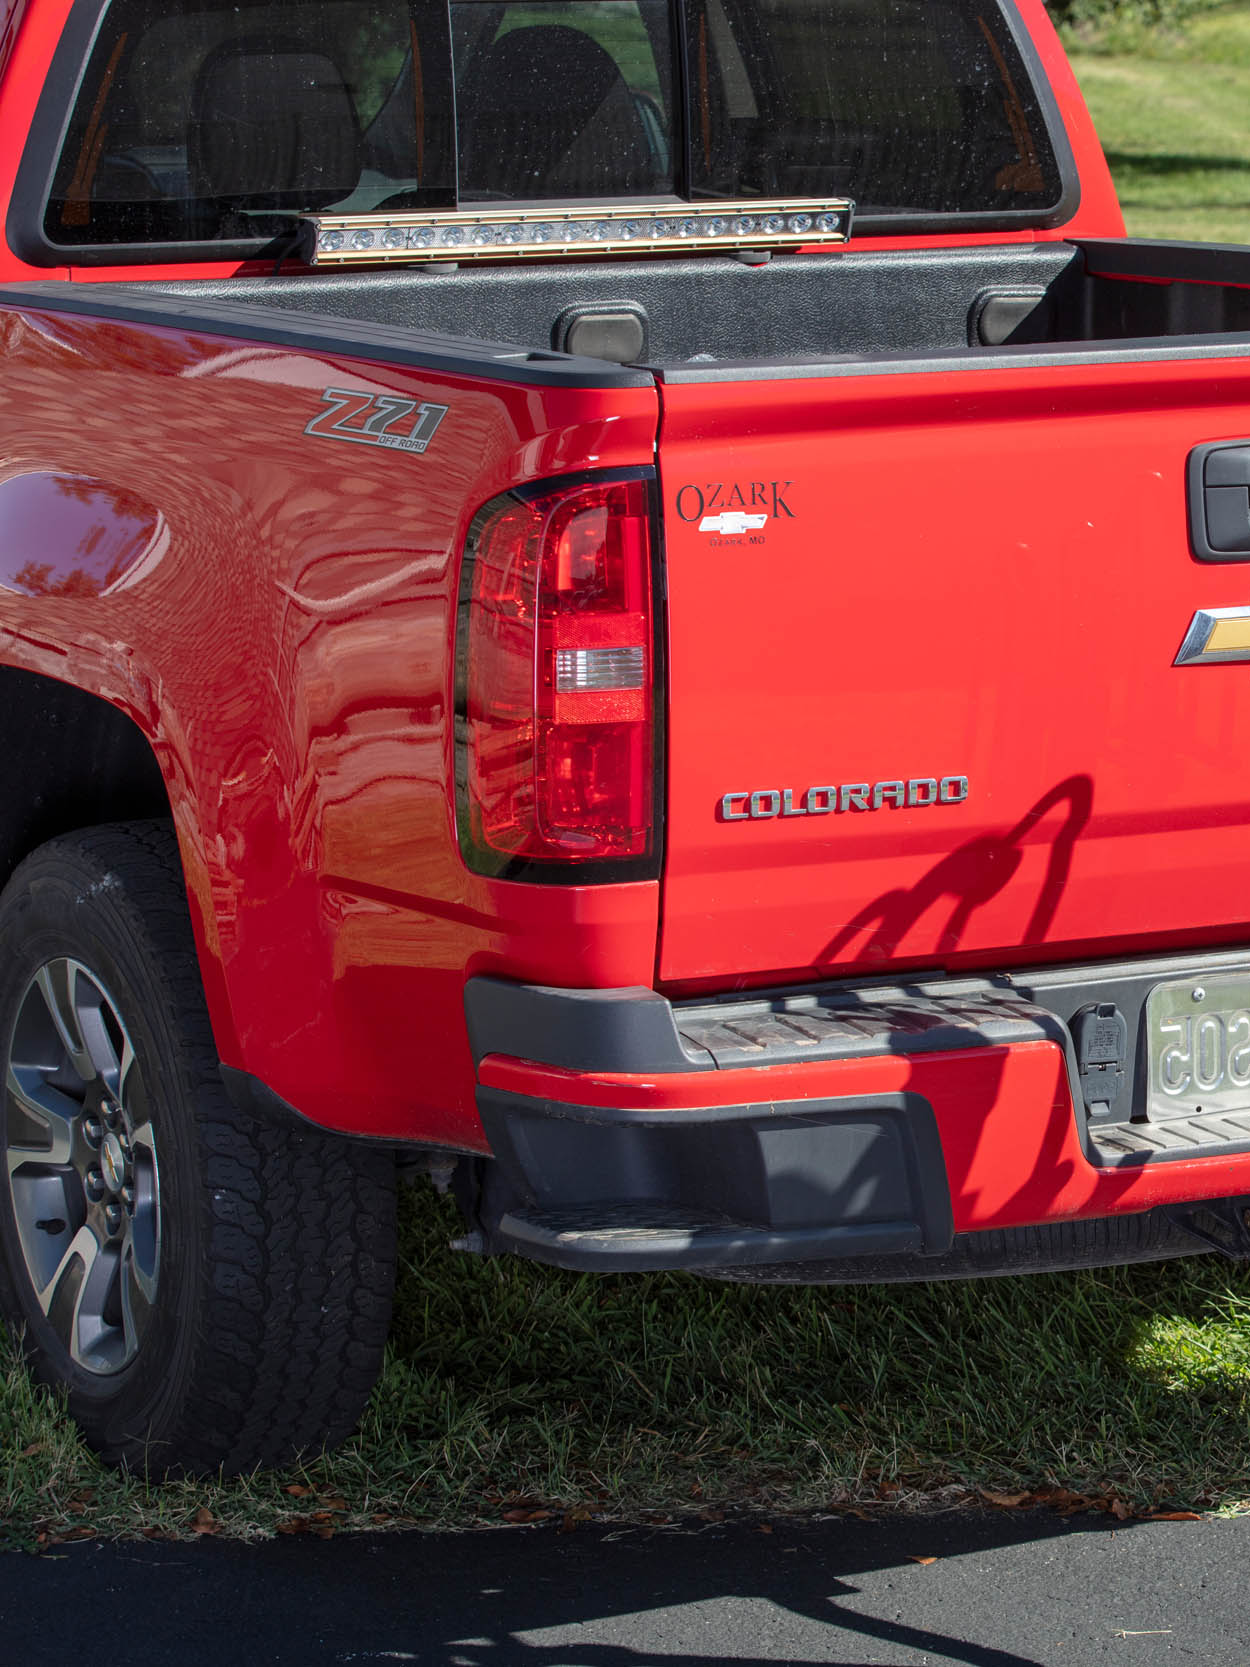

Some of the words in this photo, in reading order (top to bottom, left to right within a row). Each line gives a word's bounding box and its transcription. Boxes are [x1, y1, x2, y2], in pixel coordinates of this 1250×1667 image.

[303, 387, 449, 451] Z71
[378, 435, 398, 446] OFF
[399, 438, 426, 450] ROAD
[676, 481, 797, 522] OZARK
[748, 535, 766, 545] MO
[722, 775, 969, 821] COLORADO
